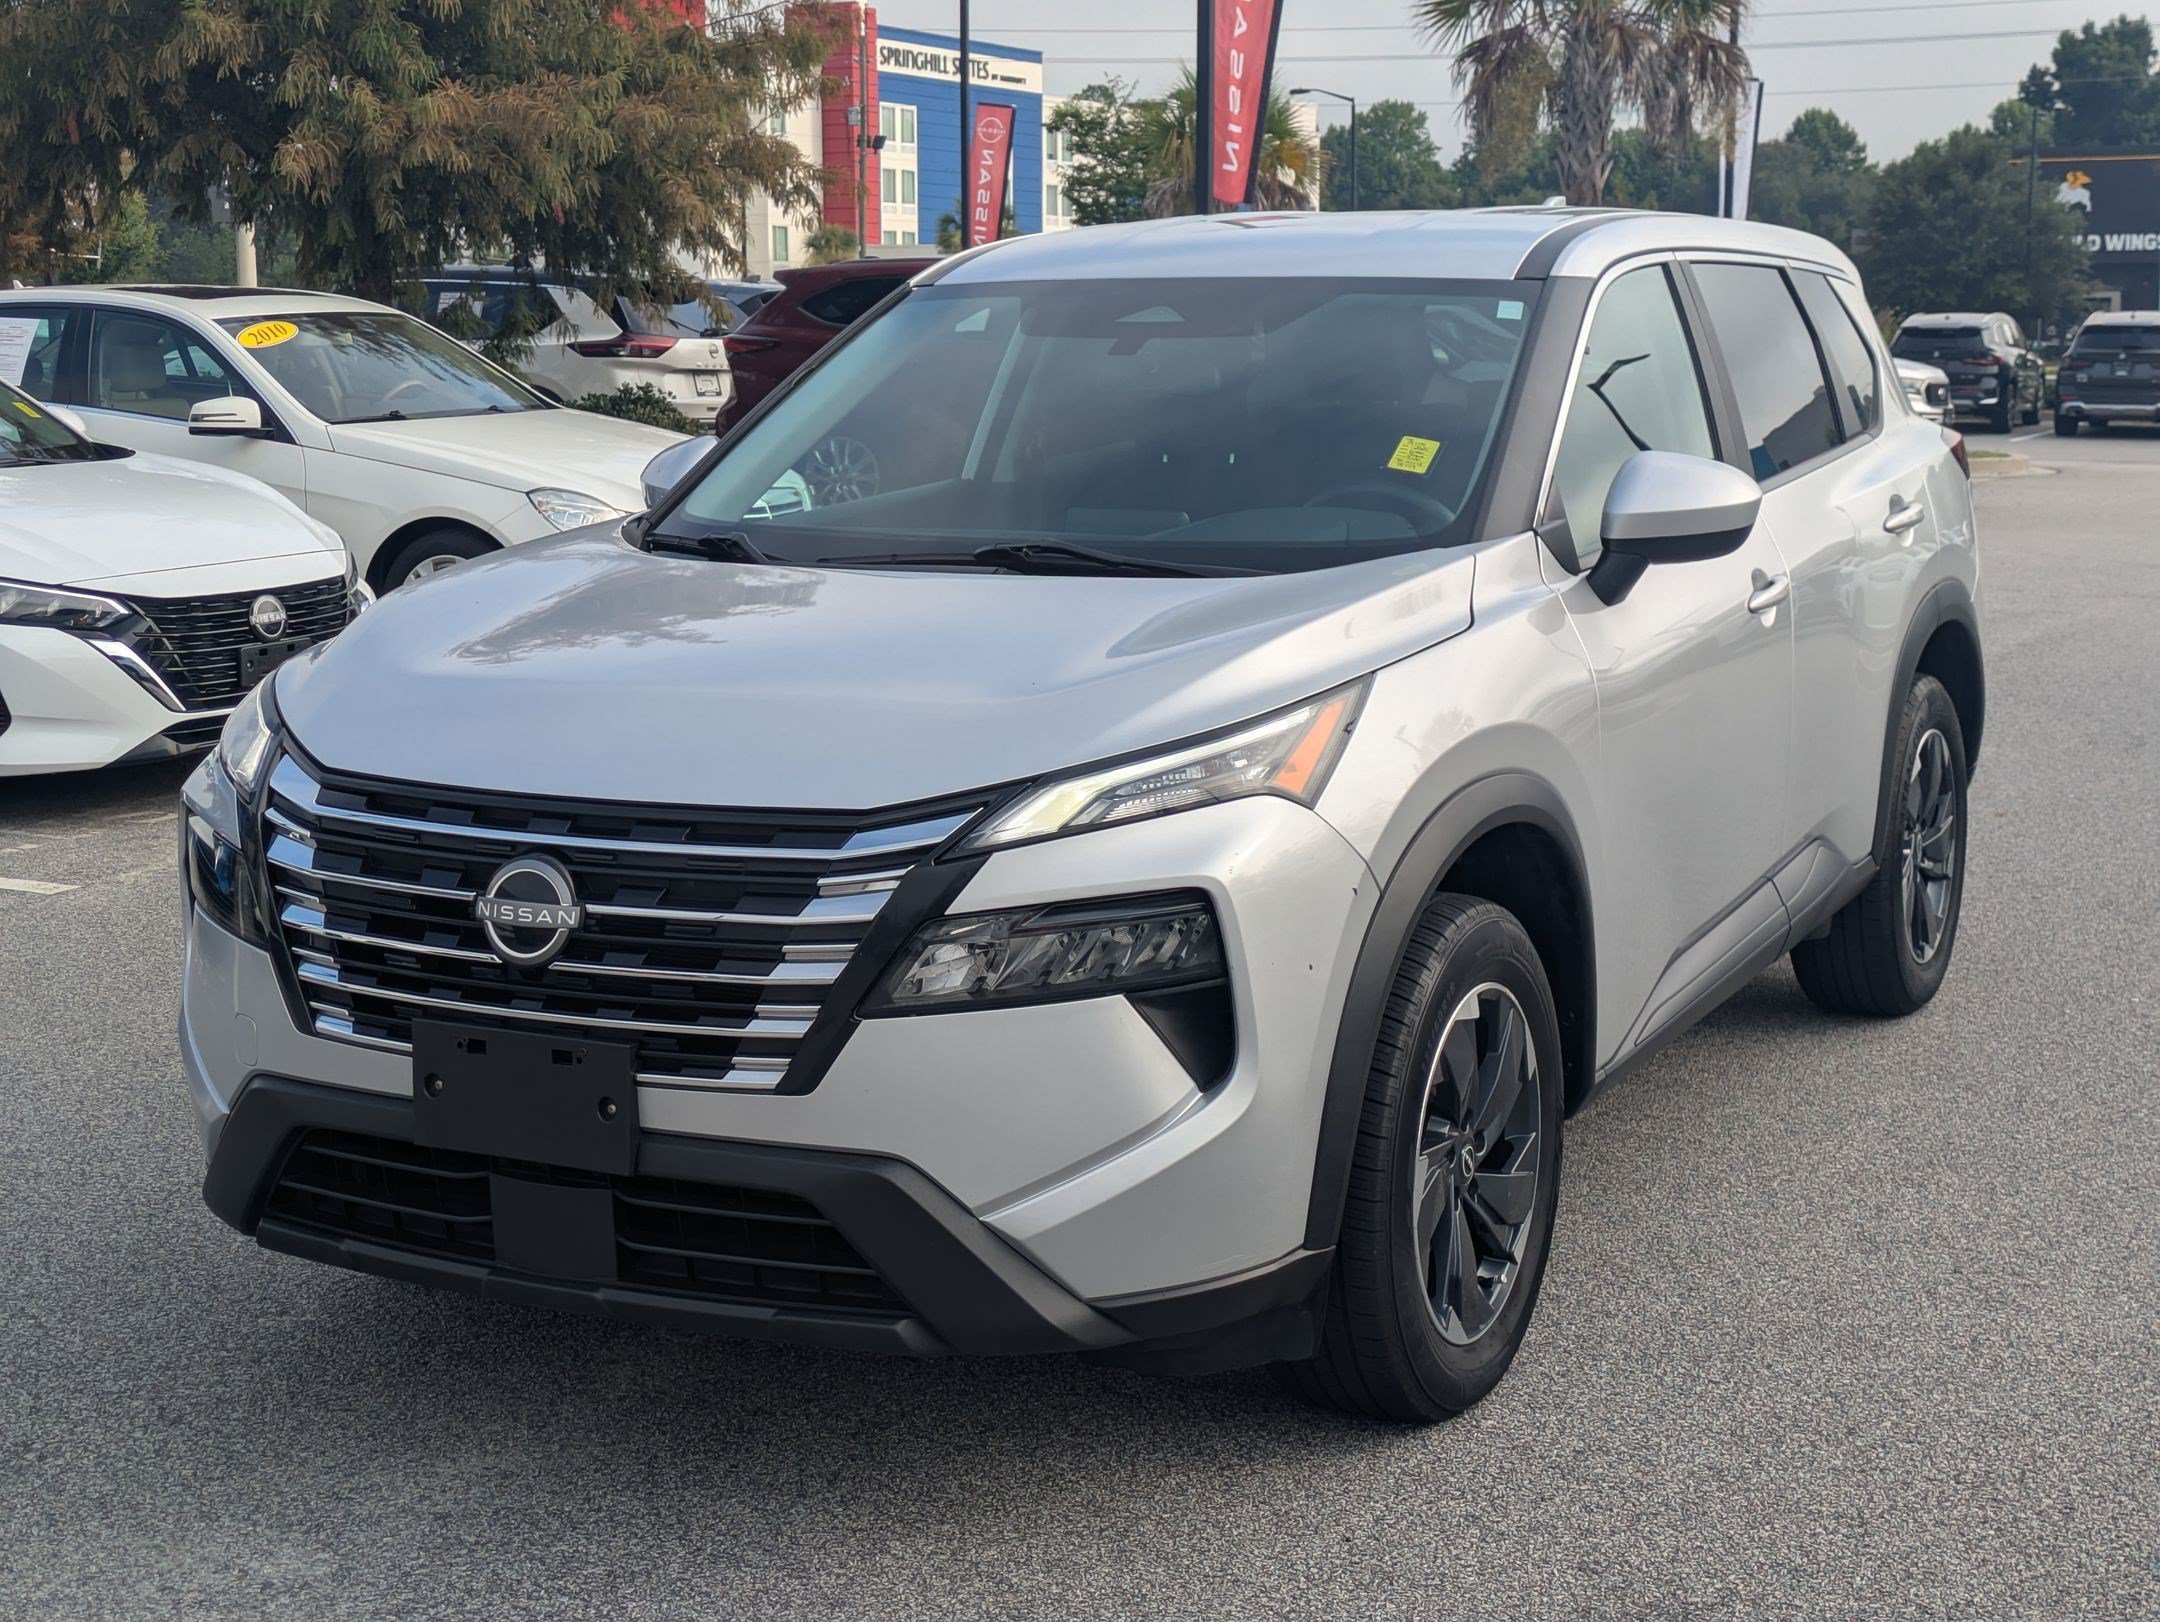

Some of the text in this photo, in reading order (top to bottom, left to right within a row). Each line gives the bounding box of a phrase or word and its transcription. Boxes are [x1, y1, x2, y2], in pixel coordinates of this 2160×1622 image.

[879, 45, 949, 74] SPRINGHILL
[952, 57, 990, 80] STES
[2104, 233, 2160, 252] WING
[247, 323, 288, 346] 2010
[252, 612, 287, 625] NISSAN
[478, 901, 576, 925] NISSAN
